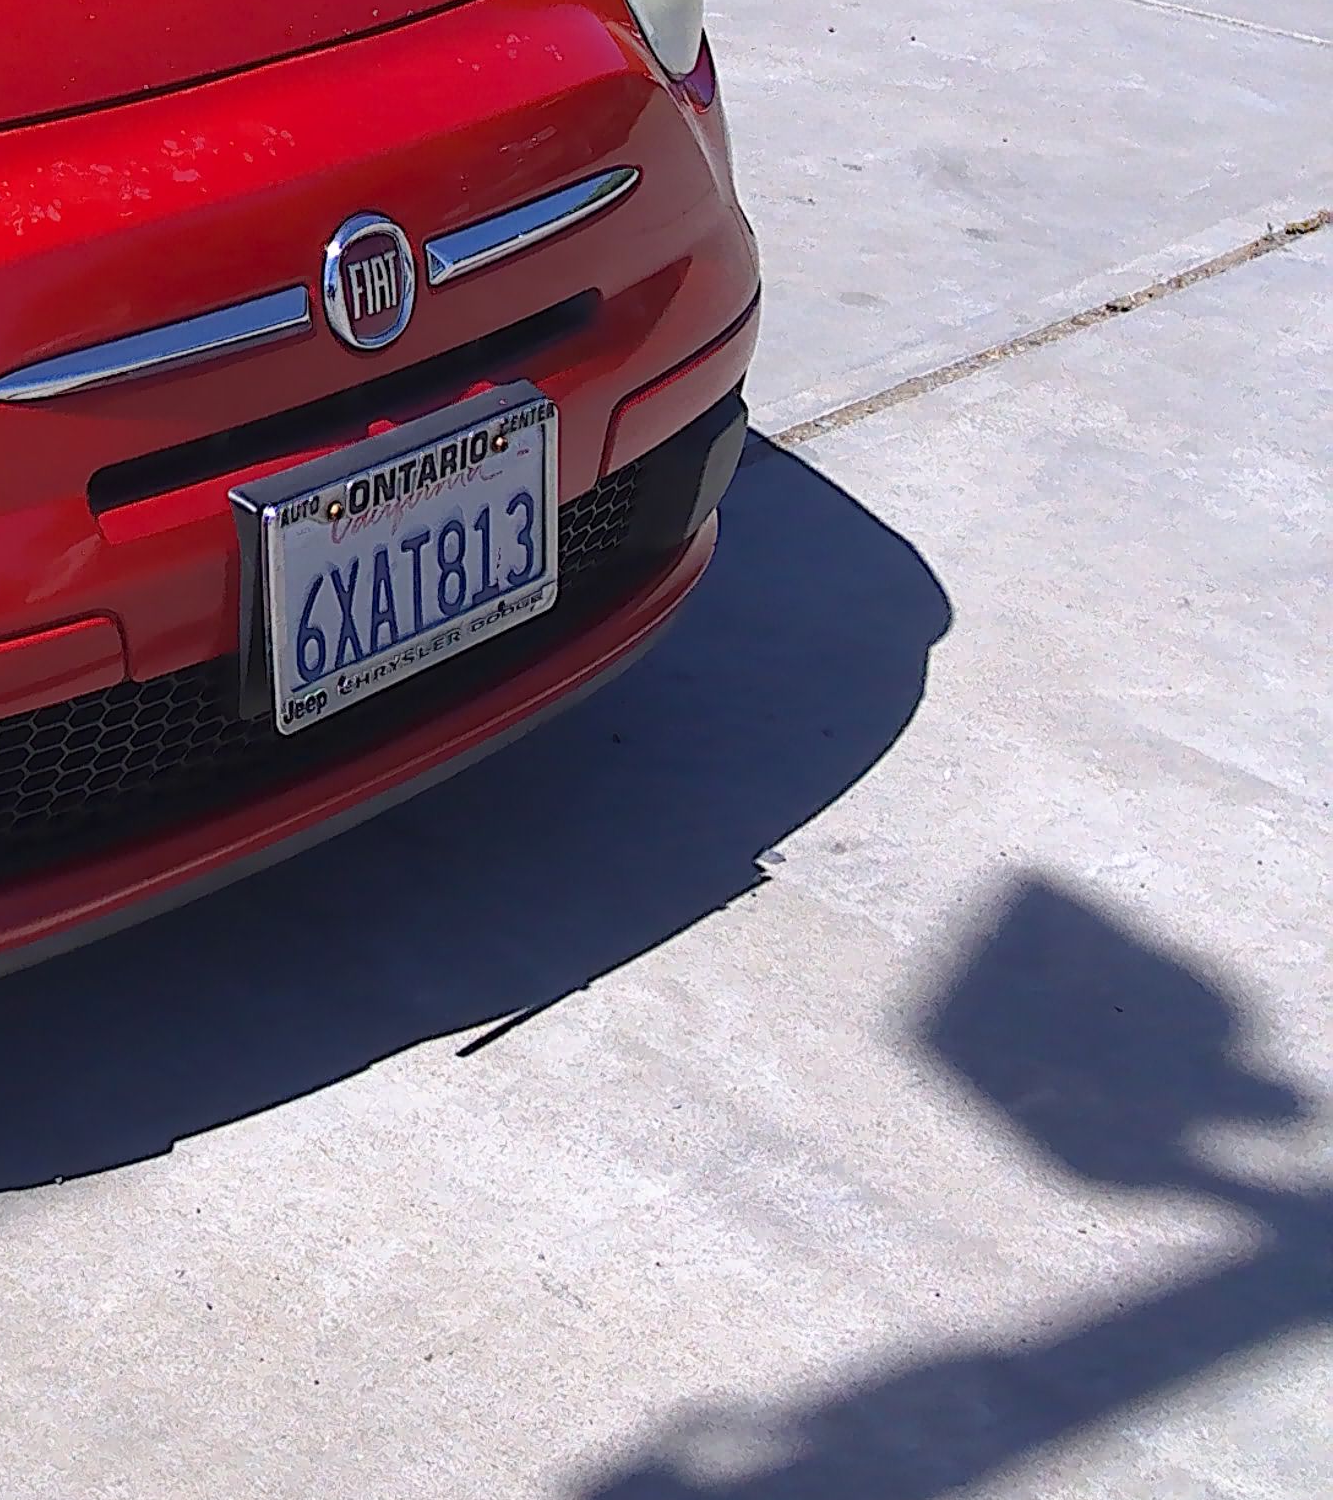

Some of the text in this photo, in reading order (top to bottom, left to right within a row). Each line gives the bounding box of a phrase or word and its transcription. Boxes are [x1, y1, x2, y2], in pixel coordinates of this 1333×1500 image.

[347, 250, 398, 321] FIAT
[280, 402, 556, 528] AUTO ONTARIO CENTER
[296, 492, 535, 683] 6XAT813
[283, 688, 328, 725] Jeep
[336, 628, 462, 696] CHRYSLER
